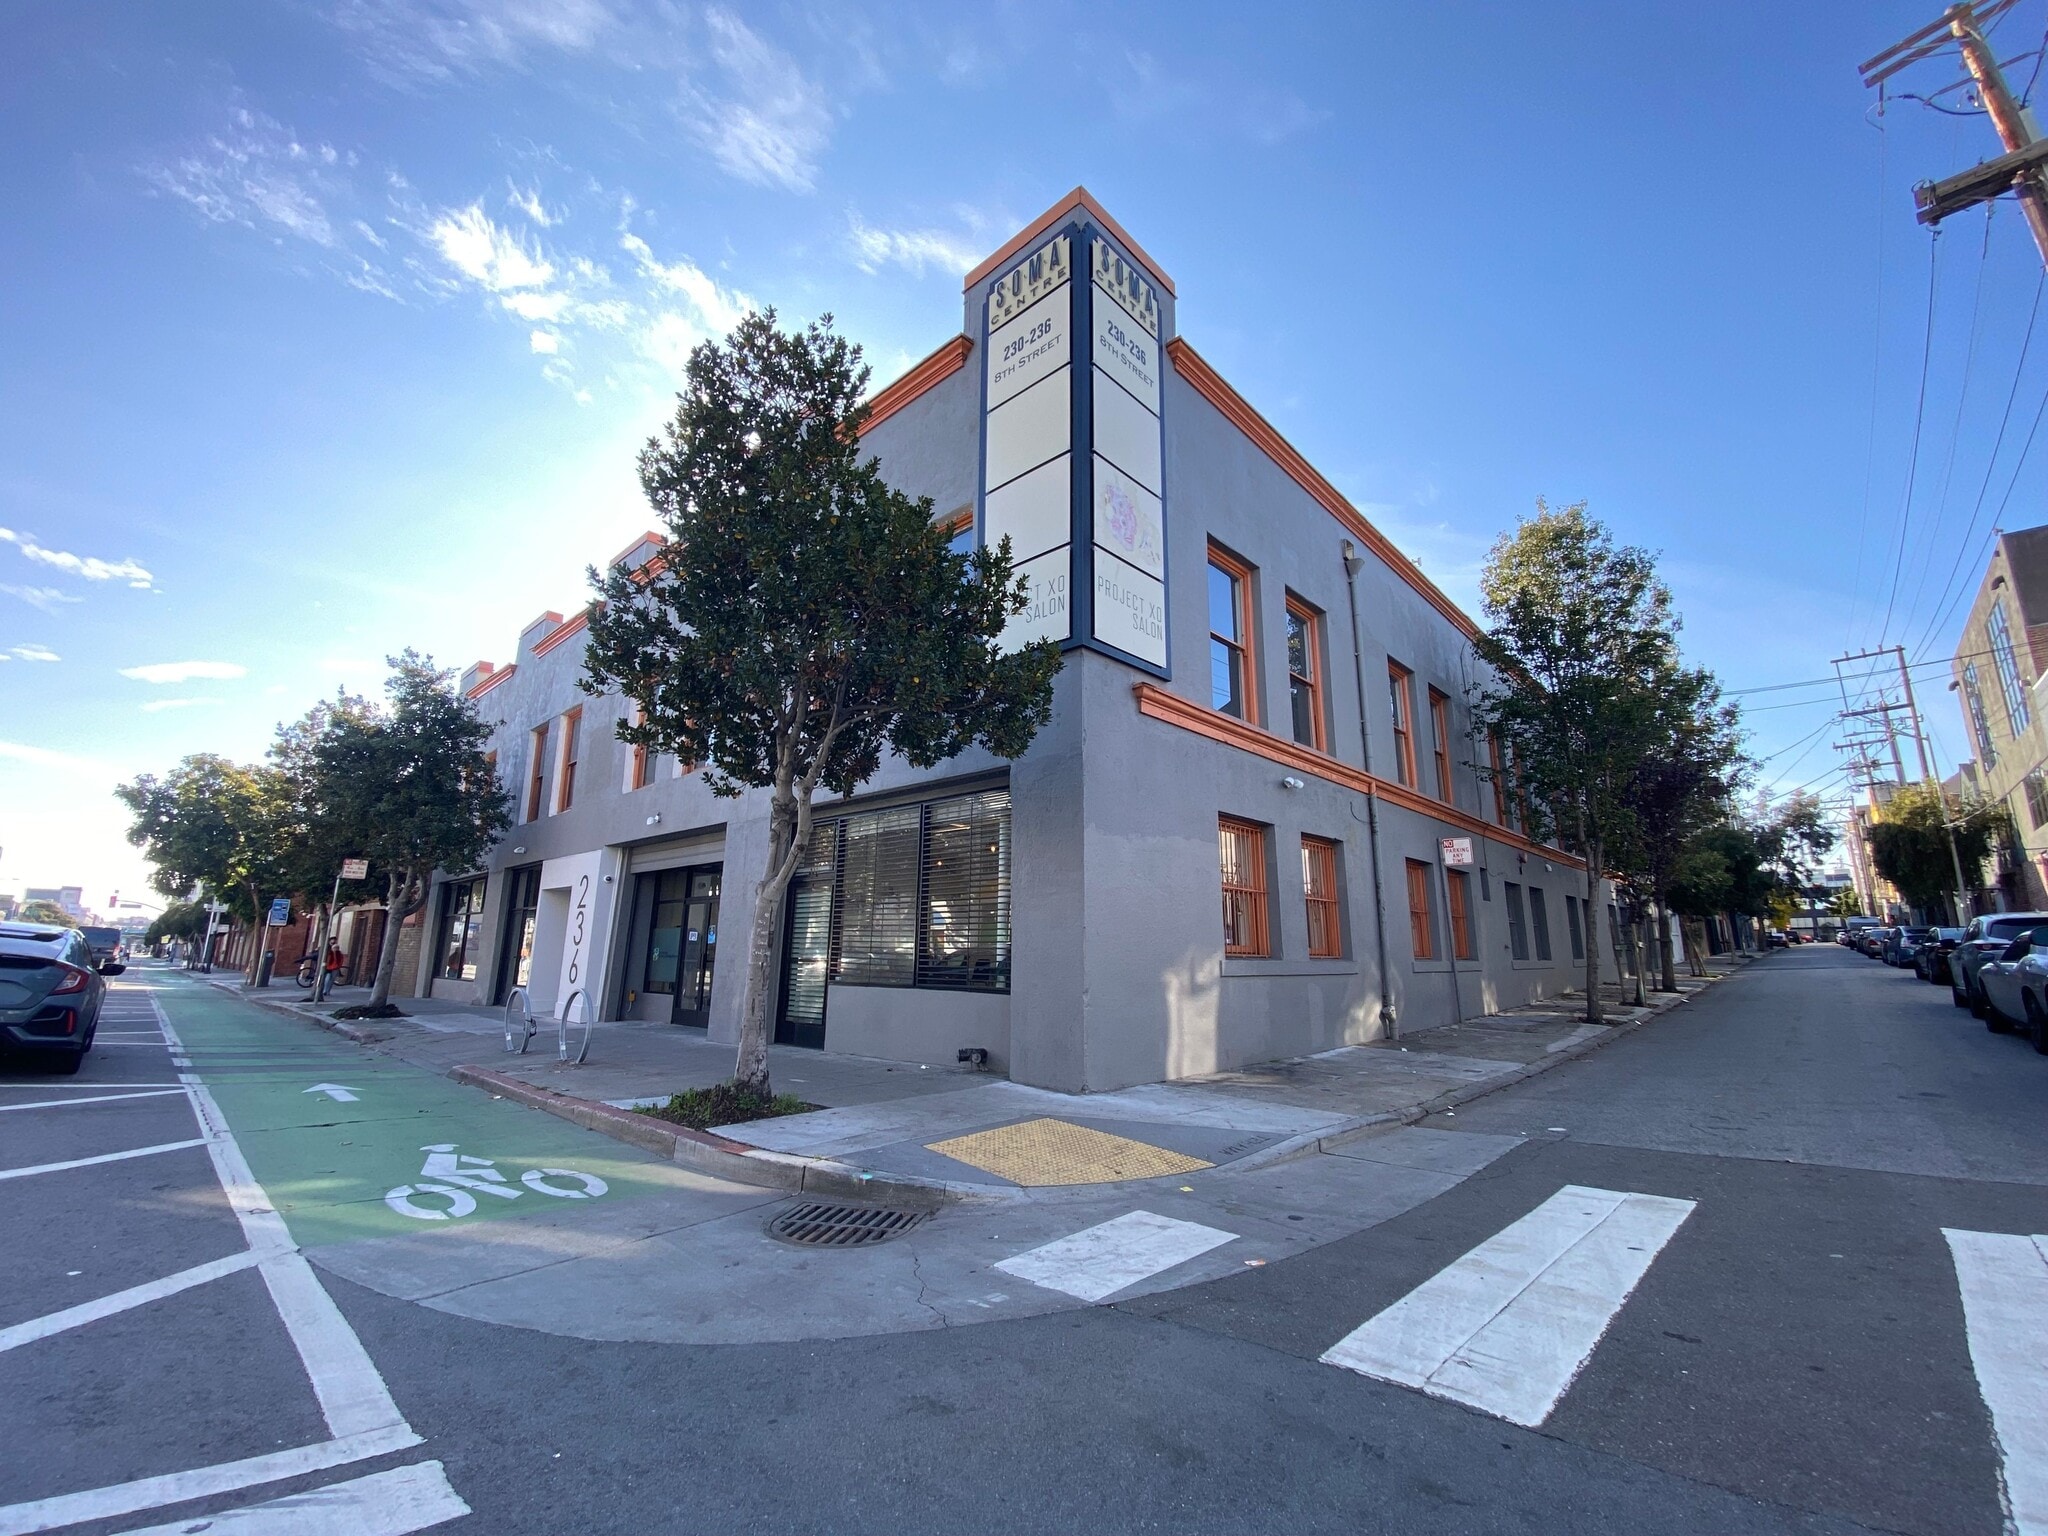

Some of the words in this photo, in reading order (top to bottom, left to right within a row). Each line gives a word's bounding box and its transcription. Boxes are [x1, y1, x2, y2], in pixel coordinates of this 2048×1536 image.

[991, 266, 1066, 325] CENTRE
[1096, 269, 1157, 332] CENTRE
[994, 364, 1016, 383] 8TH
[1018, 333, 1062, 368] STREET
[1003, 317, 1052, 361] 230-236
[1100, 334, 1119, 358] 8TH
[1120, 353, 1155, 388] STREET
[1107, 320, 1146, 366] 230-236
[1025, 594, 1065, 623] SALON
[1047, 575, 1065, 596] XO
[1097, 575, 1144, 614] PROJECT
[1149, 602, 1162, 622] XO
[1132, 613, 1163, 640] SALON
[1443, 840, 1453, 848] NO
[569, 874, 589, 985] 236
